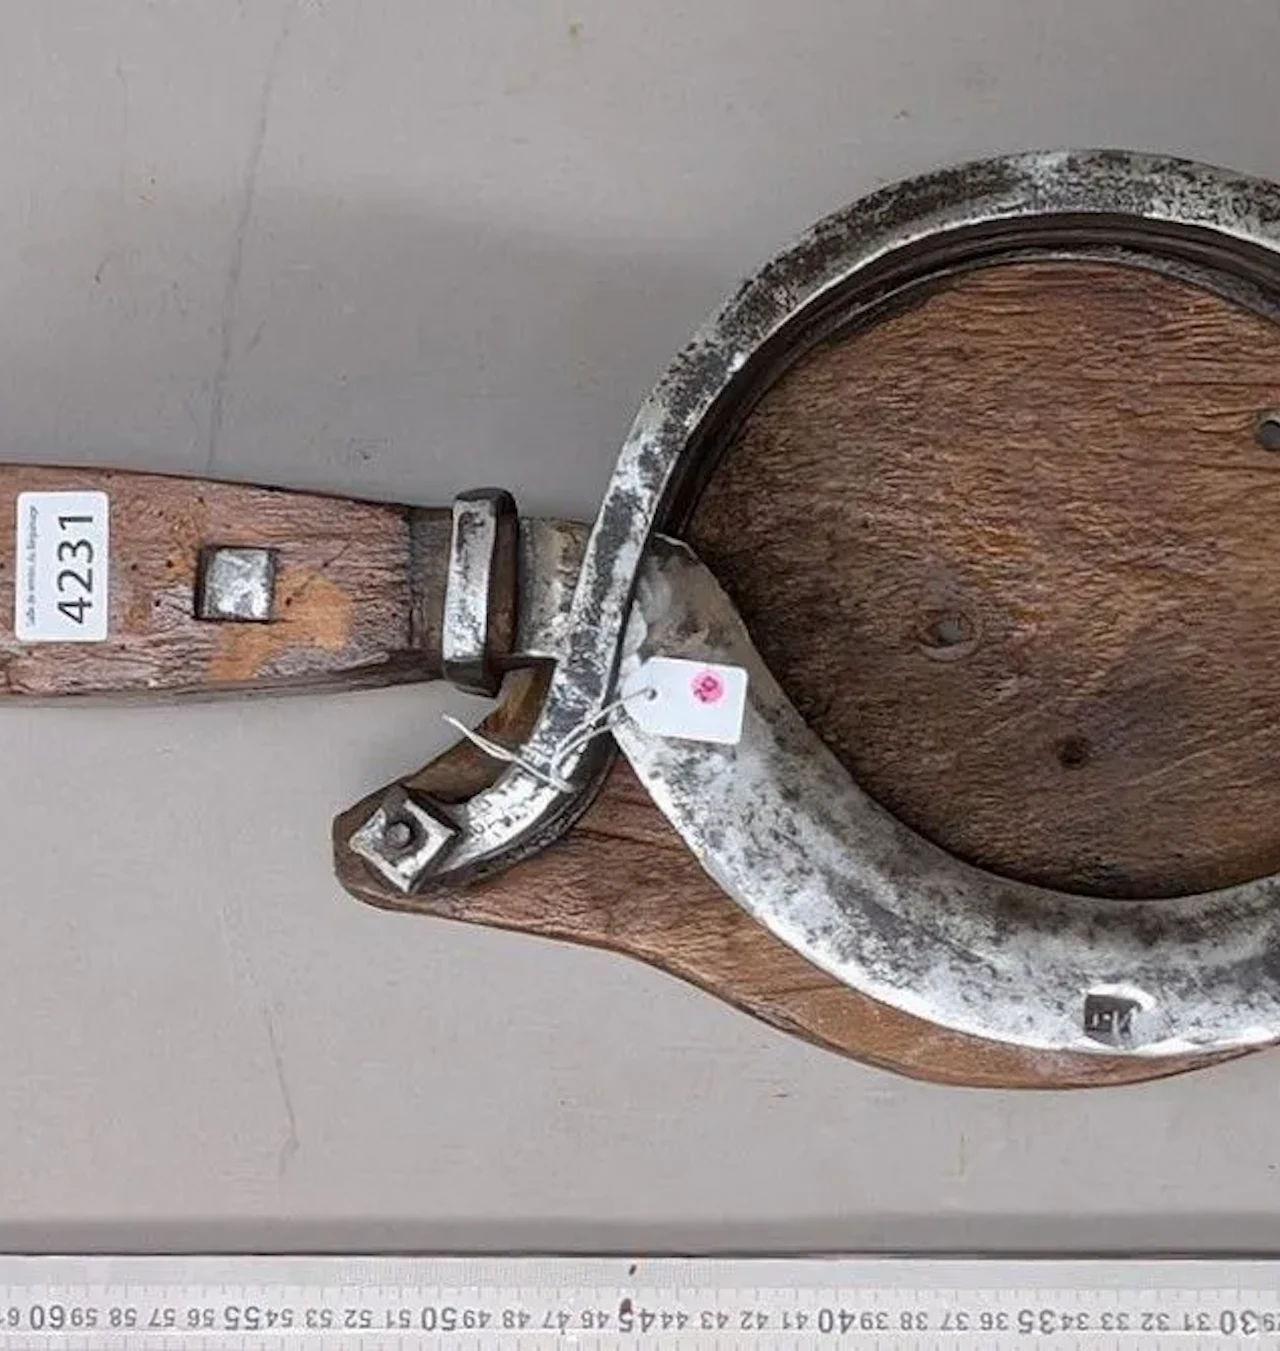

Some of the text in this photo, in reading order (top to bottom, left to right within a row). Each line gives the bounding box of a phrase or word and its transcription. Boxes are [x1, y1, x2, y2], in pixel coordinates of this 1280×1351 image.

[57, 515, 94, 624] 4231
[30, 1305, 65, 1330] 60
[71, 1308, 98, 1327] 59
[109, 1308, 137, 1327] 58
[148, 1309, 175, 1327] 57
[188, 1309, 214, 1328] 56
[224, 1306, 260, 1330] 55
[266, 1309, 293, 1327] 54
[306, 1309, 332, 1328] 53
[345, 1310, 372, 1328] 52
[387, 1309, 411, 1329] 51
[422, 1307, 457, 1331] 50
[463, 1310, 491, 1329] 49
[502, 1310, 530, 1329] 48
[542, 1311, 570, 1331] 47
[660, 1311, 689, 1330] 44
[701, 1311, 729, 1330] 43
[740, 1311, 768, 1330] 42
[783, 1311, 808, 1330] 41
[819, 1309, 855, 1334] 40
[861, 1312, 889, 1330] 39
[900, 1312, 928, 1331] 38
[940, 1312, 969, 1331] 37
[980, 1312, 1008, 1330] 36
[1018, 1310, 1055, 1334] 35
[1061, 1313, 1089, 1331] 34
[1100, 1313, 1130, 1331] 33
[1141, 1313, 1170, 1331] 32
[1183, 1313, 1211, 1331] 31
[1220, 1310, 1258, 1335] 30
